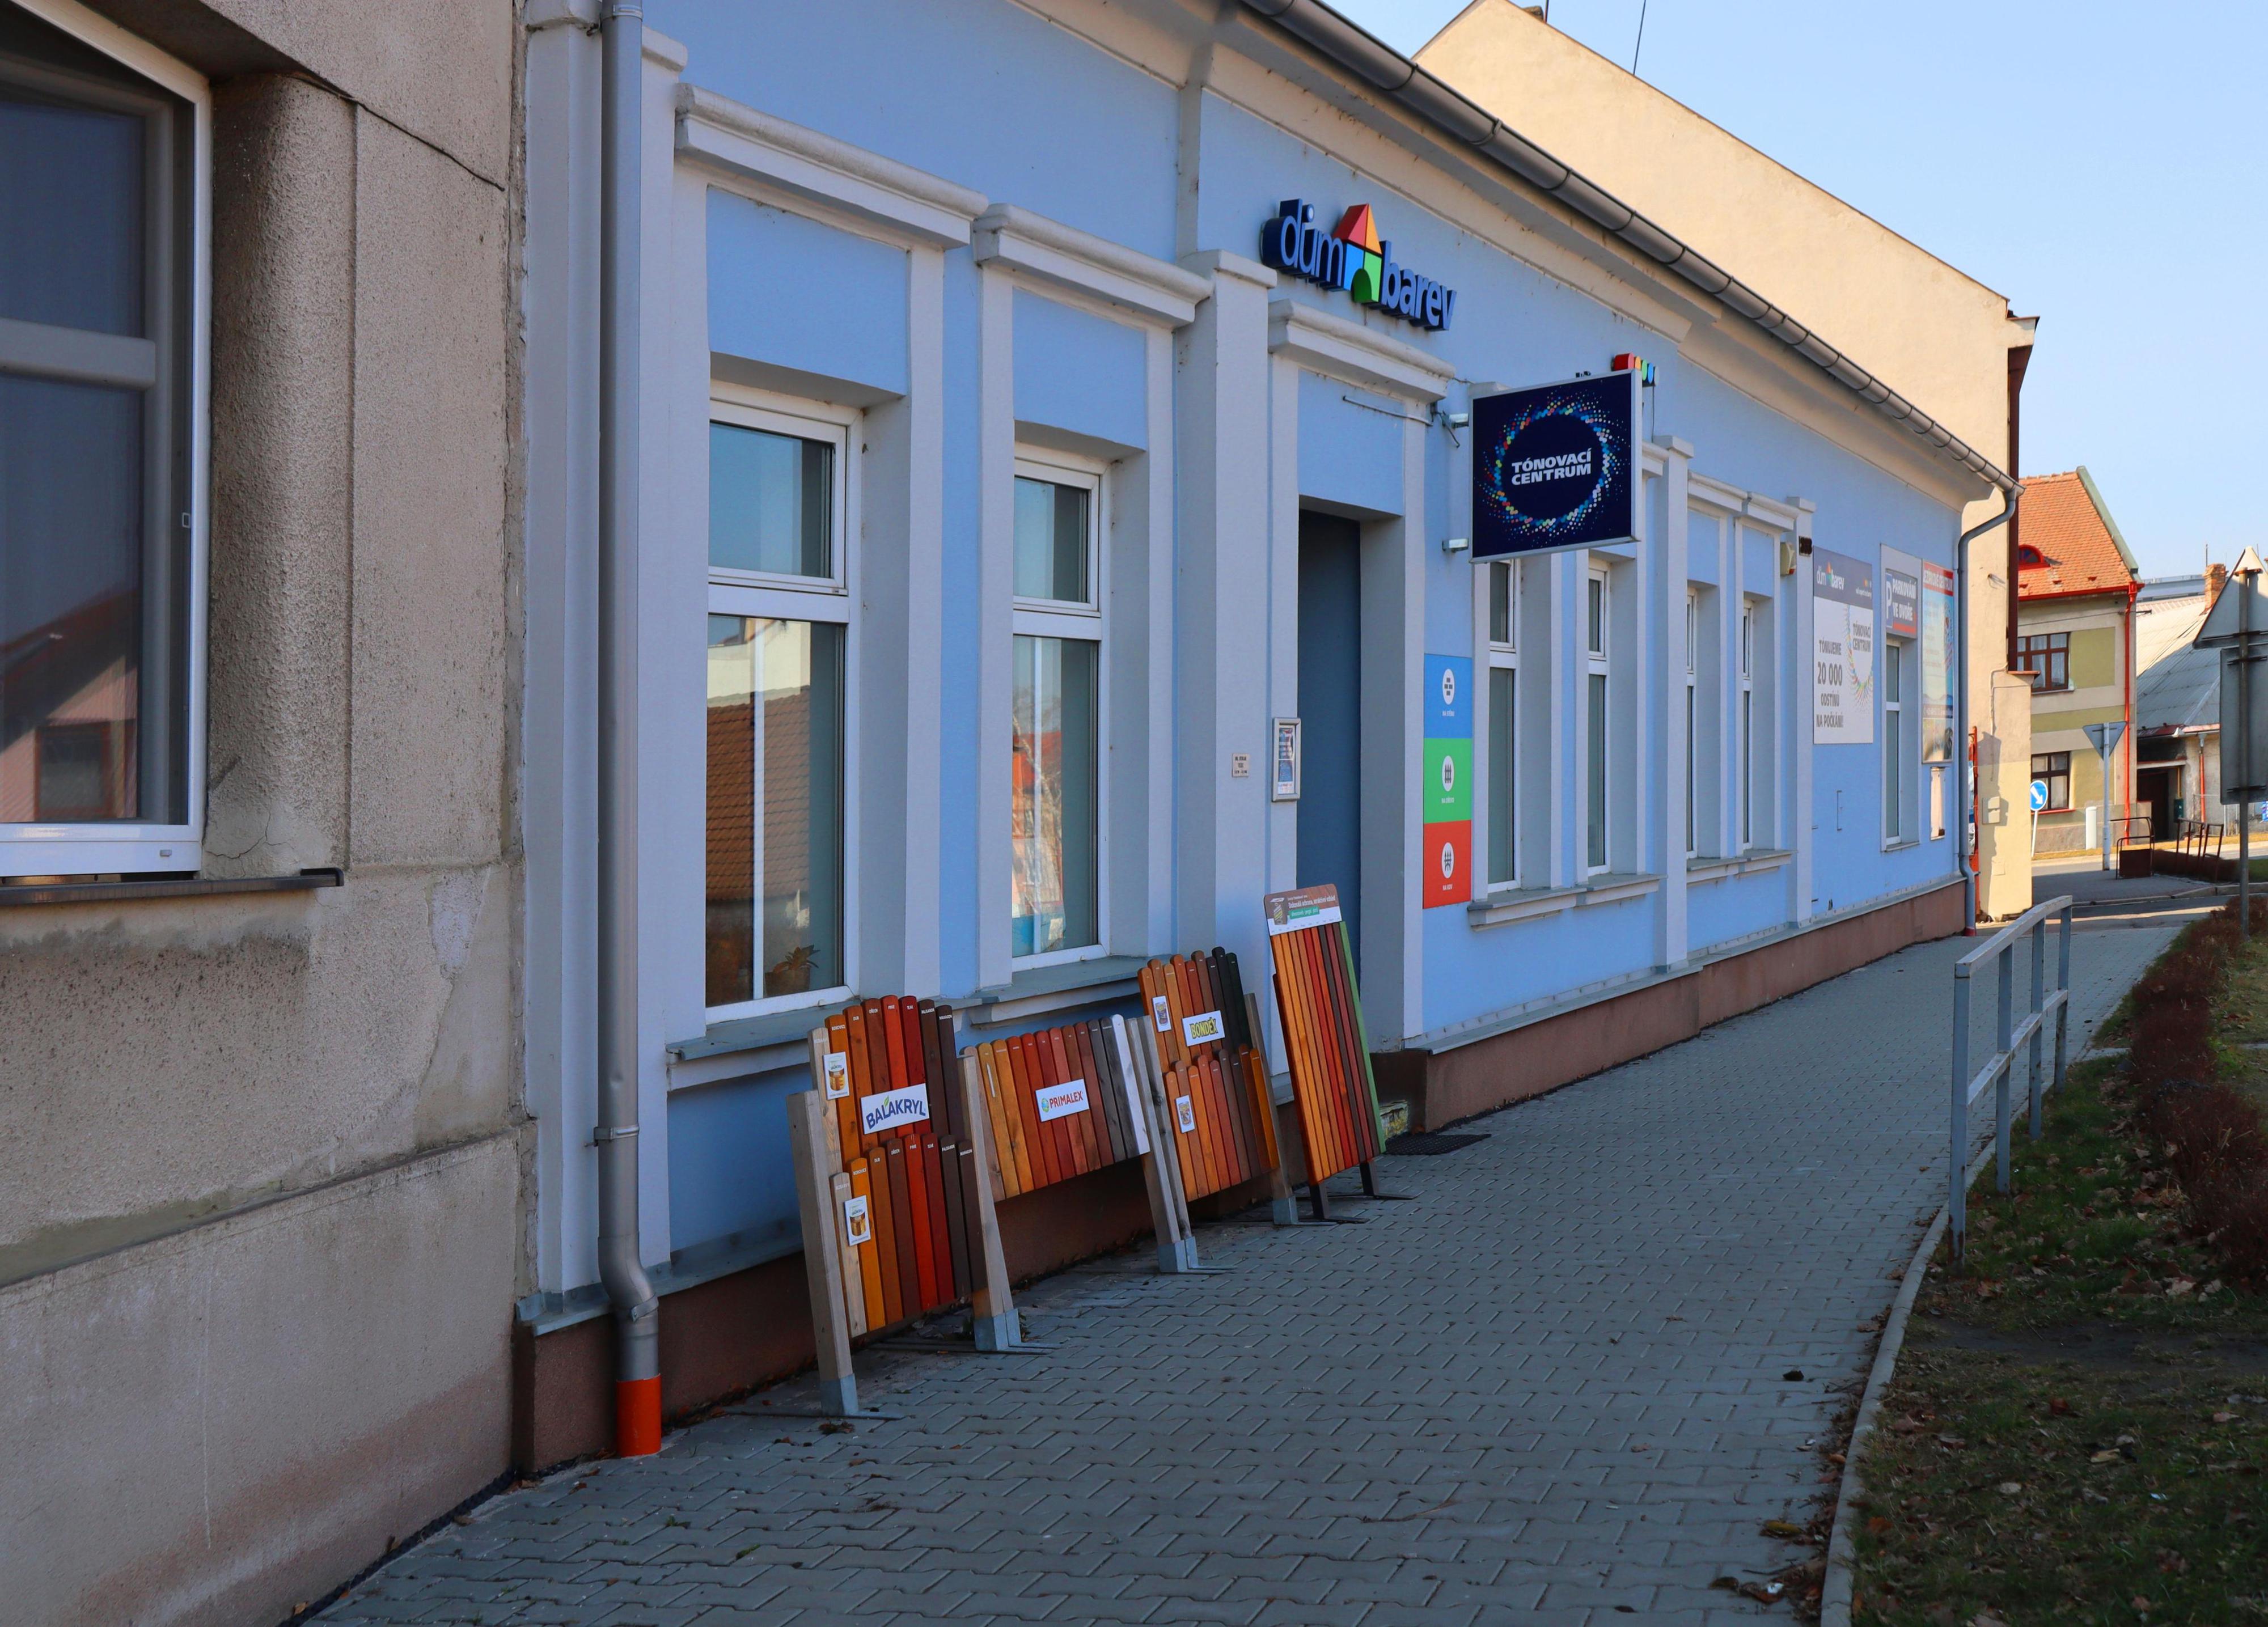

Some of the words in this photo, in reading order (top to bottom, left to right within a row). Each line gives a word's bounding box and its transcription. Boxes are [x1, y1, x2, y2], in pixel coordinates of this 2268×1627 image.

[1270, 198, 1344, 288] dům
[1381, 240, 1457, 331] barev
[1511, 448, 1592, 473] TÓNOVACÍ
[1511, 463, 1592, 486] CENTRUM
[1831, 569, 1844, 590] barev
[1892, 578, 1916, 599] PARKOVÁNÍ
[1886, 581, 1892, 620] P
[1893, 601, 1898, 618] VE
[1899, 602, 1913, 621] DVOŘE
[1852, 621, 1871, 638] TÓNOVACÍ
[1819, 637, 1842, 655] TÓNUJEME
[1852, 638, 1871, 653] CENTRUM
[1817, 661, 1826, 685] 20
[1829, 663, 1843, 687] 000
[1821, 690, 1840, 707] ODSTÍNŮ
[1816, 714, 1822, 728] NA
[1190, 1016, 1218, 1039] BONDEX
[1049, 1091, 1084, 1109] PRIMALEX
[865, 1099, 926, 1130] BALAKRYL
